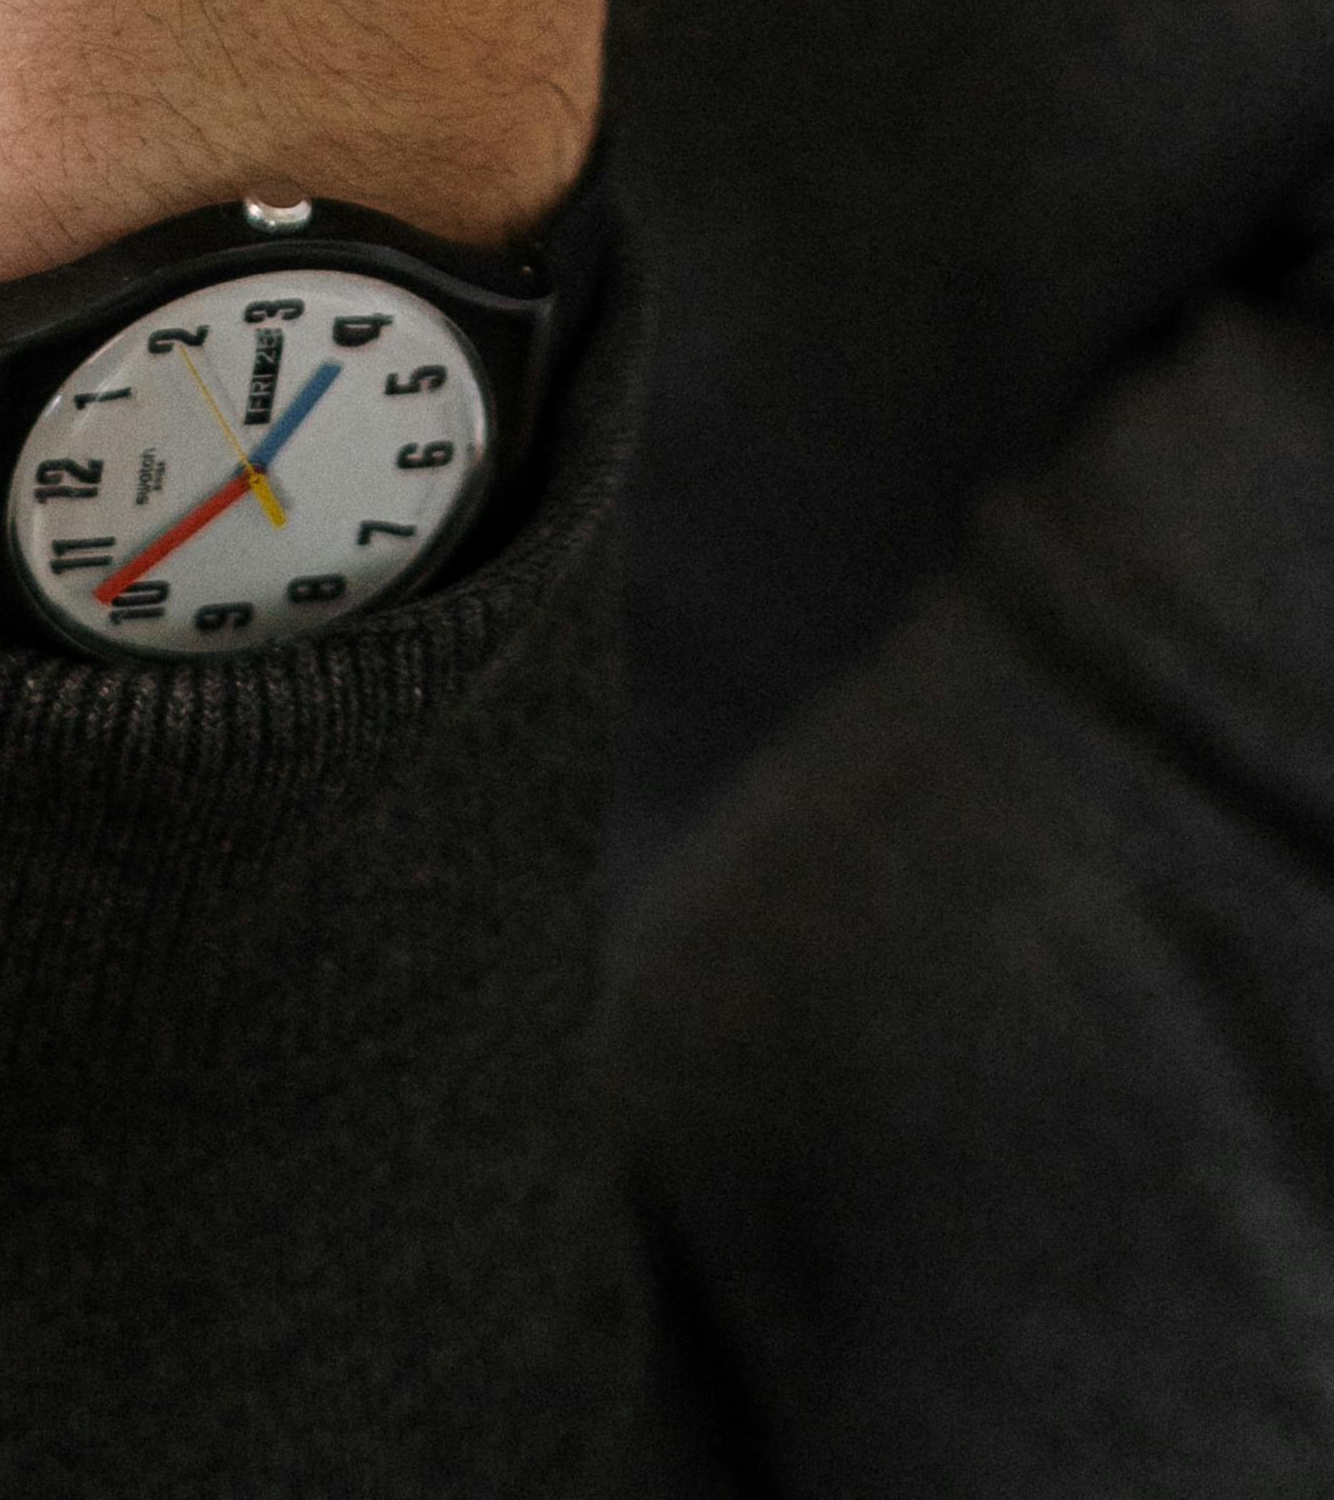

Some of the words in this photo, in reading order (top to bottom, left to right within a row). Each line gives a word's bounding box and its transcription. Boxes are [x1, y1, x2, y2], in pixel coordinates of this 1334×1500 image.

[244, 299, 305, 324] 3
[147, 325, 210, 355] 2
[332, 312, 394, 348] 4
[384, 364, 448, 397] 5
[73, 387, 134, 411] 1
[395, 441, 456, 471] 6
[34, 457, 104, 504] 12
[357, 520, 417, 546] 7
[50, 536, 115, 575] 11
[109, 579, 171, 625] 10
[287, 573, 347, 604] 8
[194, 601, 254, 634] 9
